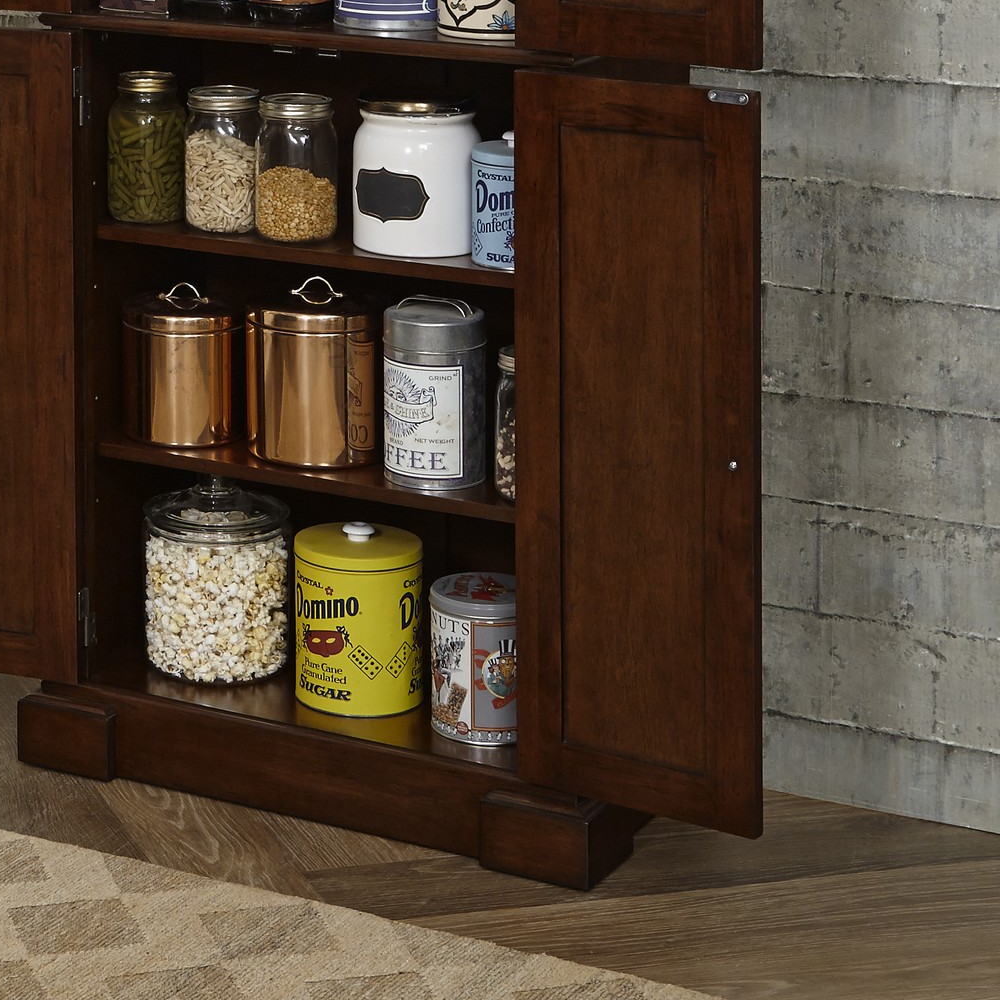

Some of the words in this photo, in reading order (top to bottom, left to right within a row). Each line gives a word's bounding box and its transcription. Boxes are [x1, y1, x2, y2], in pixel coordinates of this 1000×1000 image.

[387, 443, 448, 471] FFEE
[296, 570, 324, 589] CRYSTAL
[297, 582, 360, 620] Domino
[302, 664, 347, 684] Granulated
[304, 656, 320, 670] Pure
[321, 662, 342, 674] Cane
[300, 674, 352, 701] SUGAR
